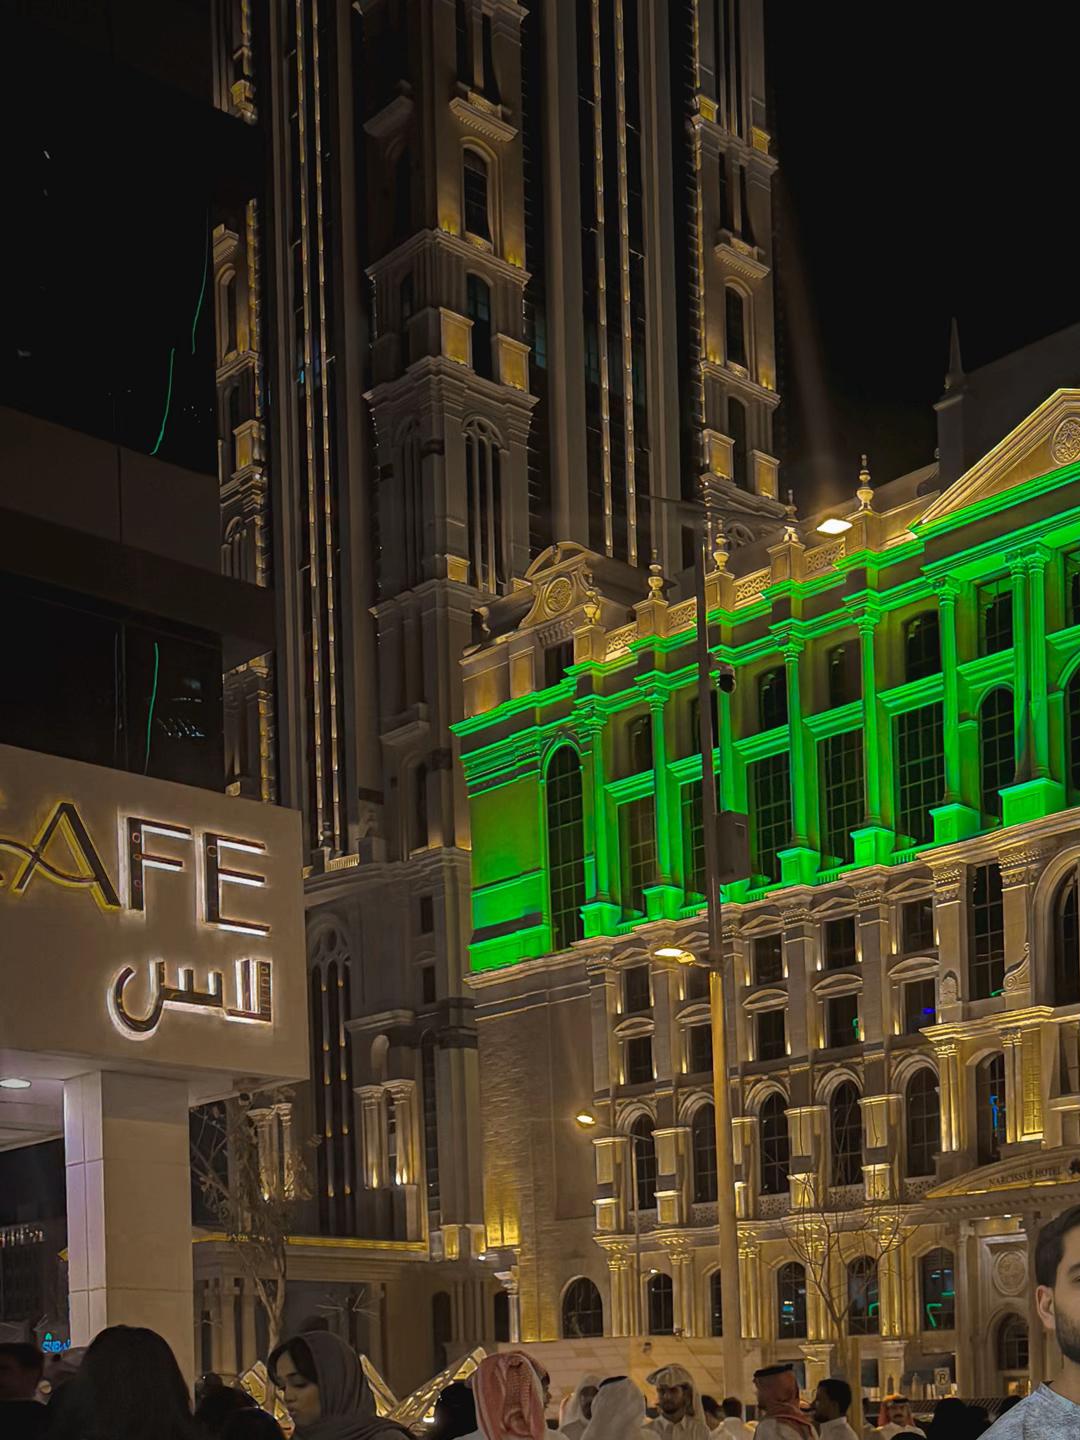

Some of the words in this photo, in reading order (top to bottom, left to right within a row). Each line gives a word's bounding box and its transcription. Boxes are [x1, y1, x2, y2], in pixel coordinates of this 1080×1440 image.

[0, 800, 271, 937] AFE
[989, 1169, 1033, 1186] NARCISSUS
[1035, 1167, 1061, 1178] HOTEL
